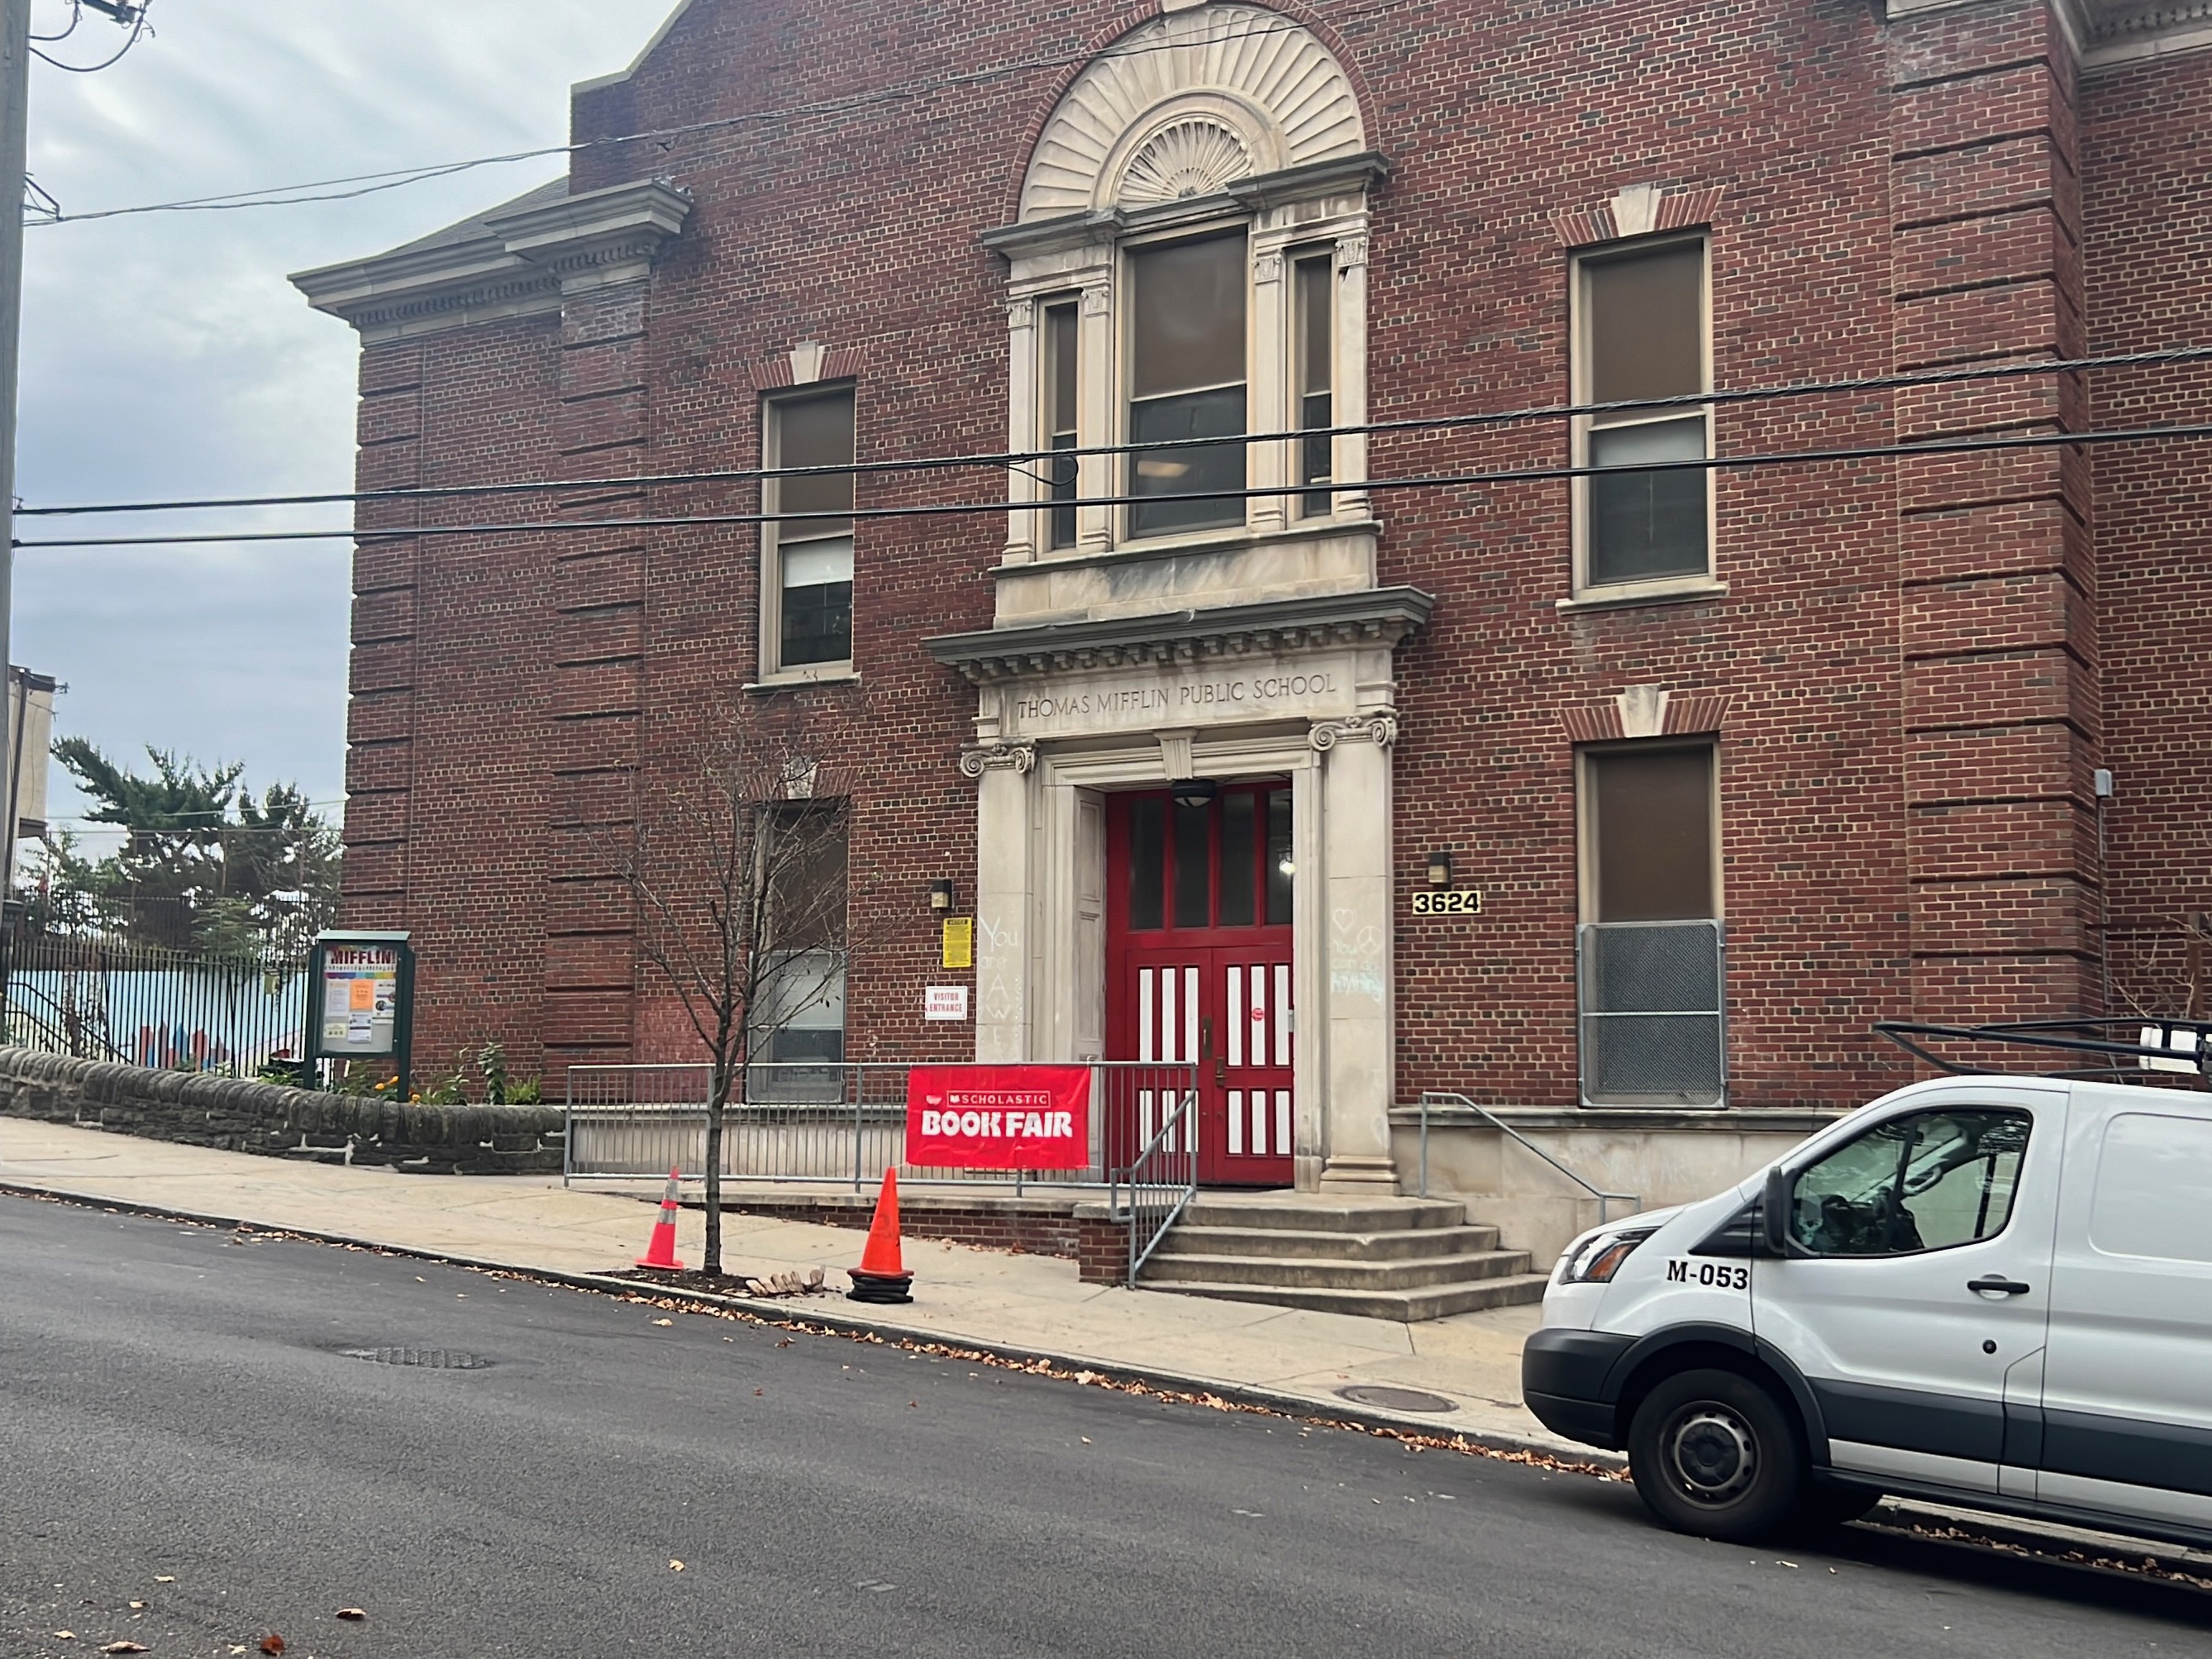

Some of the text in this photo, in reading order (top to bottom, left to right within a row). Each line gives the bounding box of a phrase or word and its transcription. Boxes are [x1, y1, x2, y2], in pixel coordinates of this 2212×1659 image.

[1018, 674, 1336, 719] THOMAS MIFFLIN PUBLIC SCHOOL
[1414, 893, 1479, 913] 3624
[980, 917, 1018, 952] You
[929, 1004, 962, 1013] ENTRANCE
[934, 993, 959, 1001] VISITOR
[961, 1094, 1047, 1105] SCHOLASTIC
[921, 1110, 1073, 1138] BOOK FAIR
[1666, 1260, 1748, 1290] M-053
